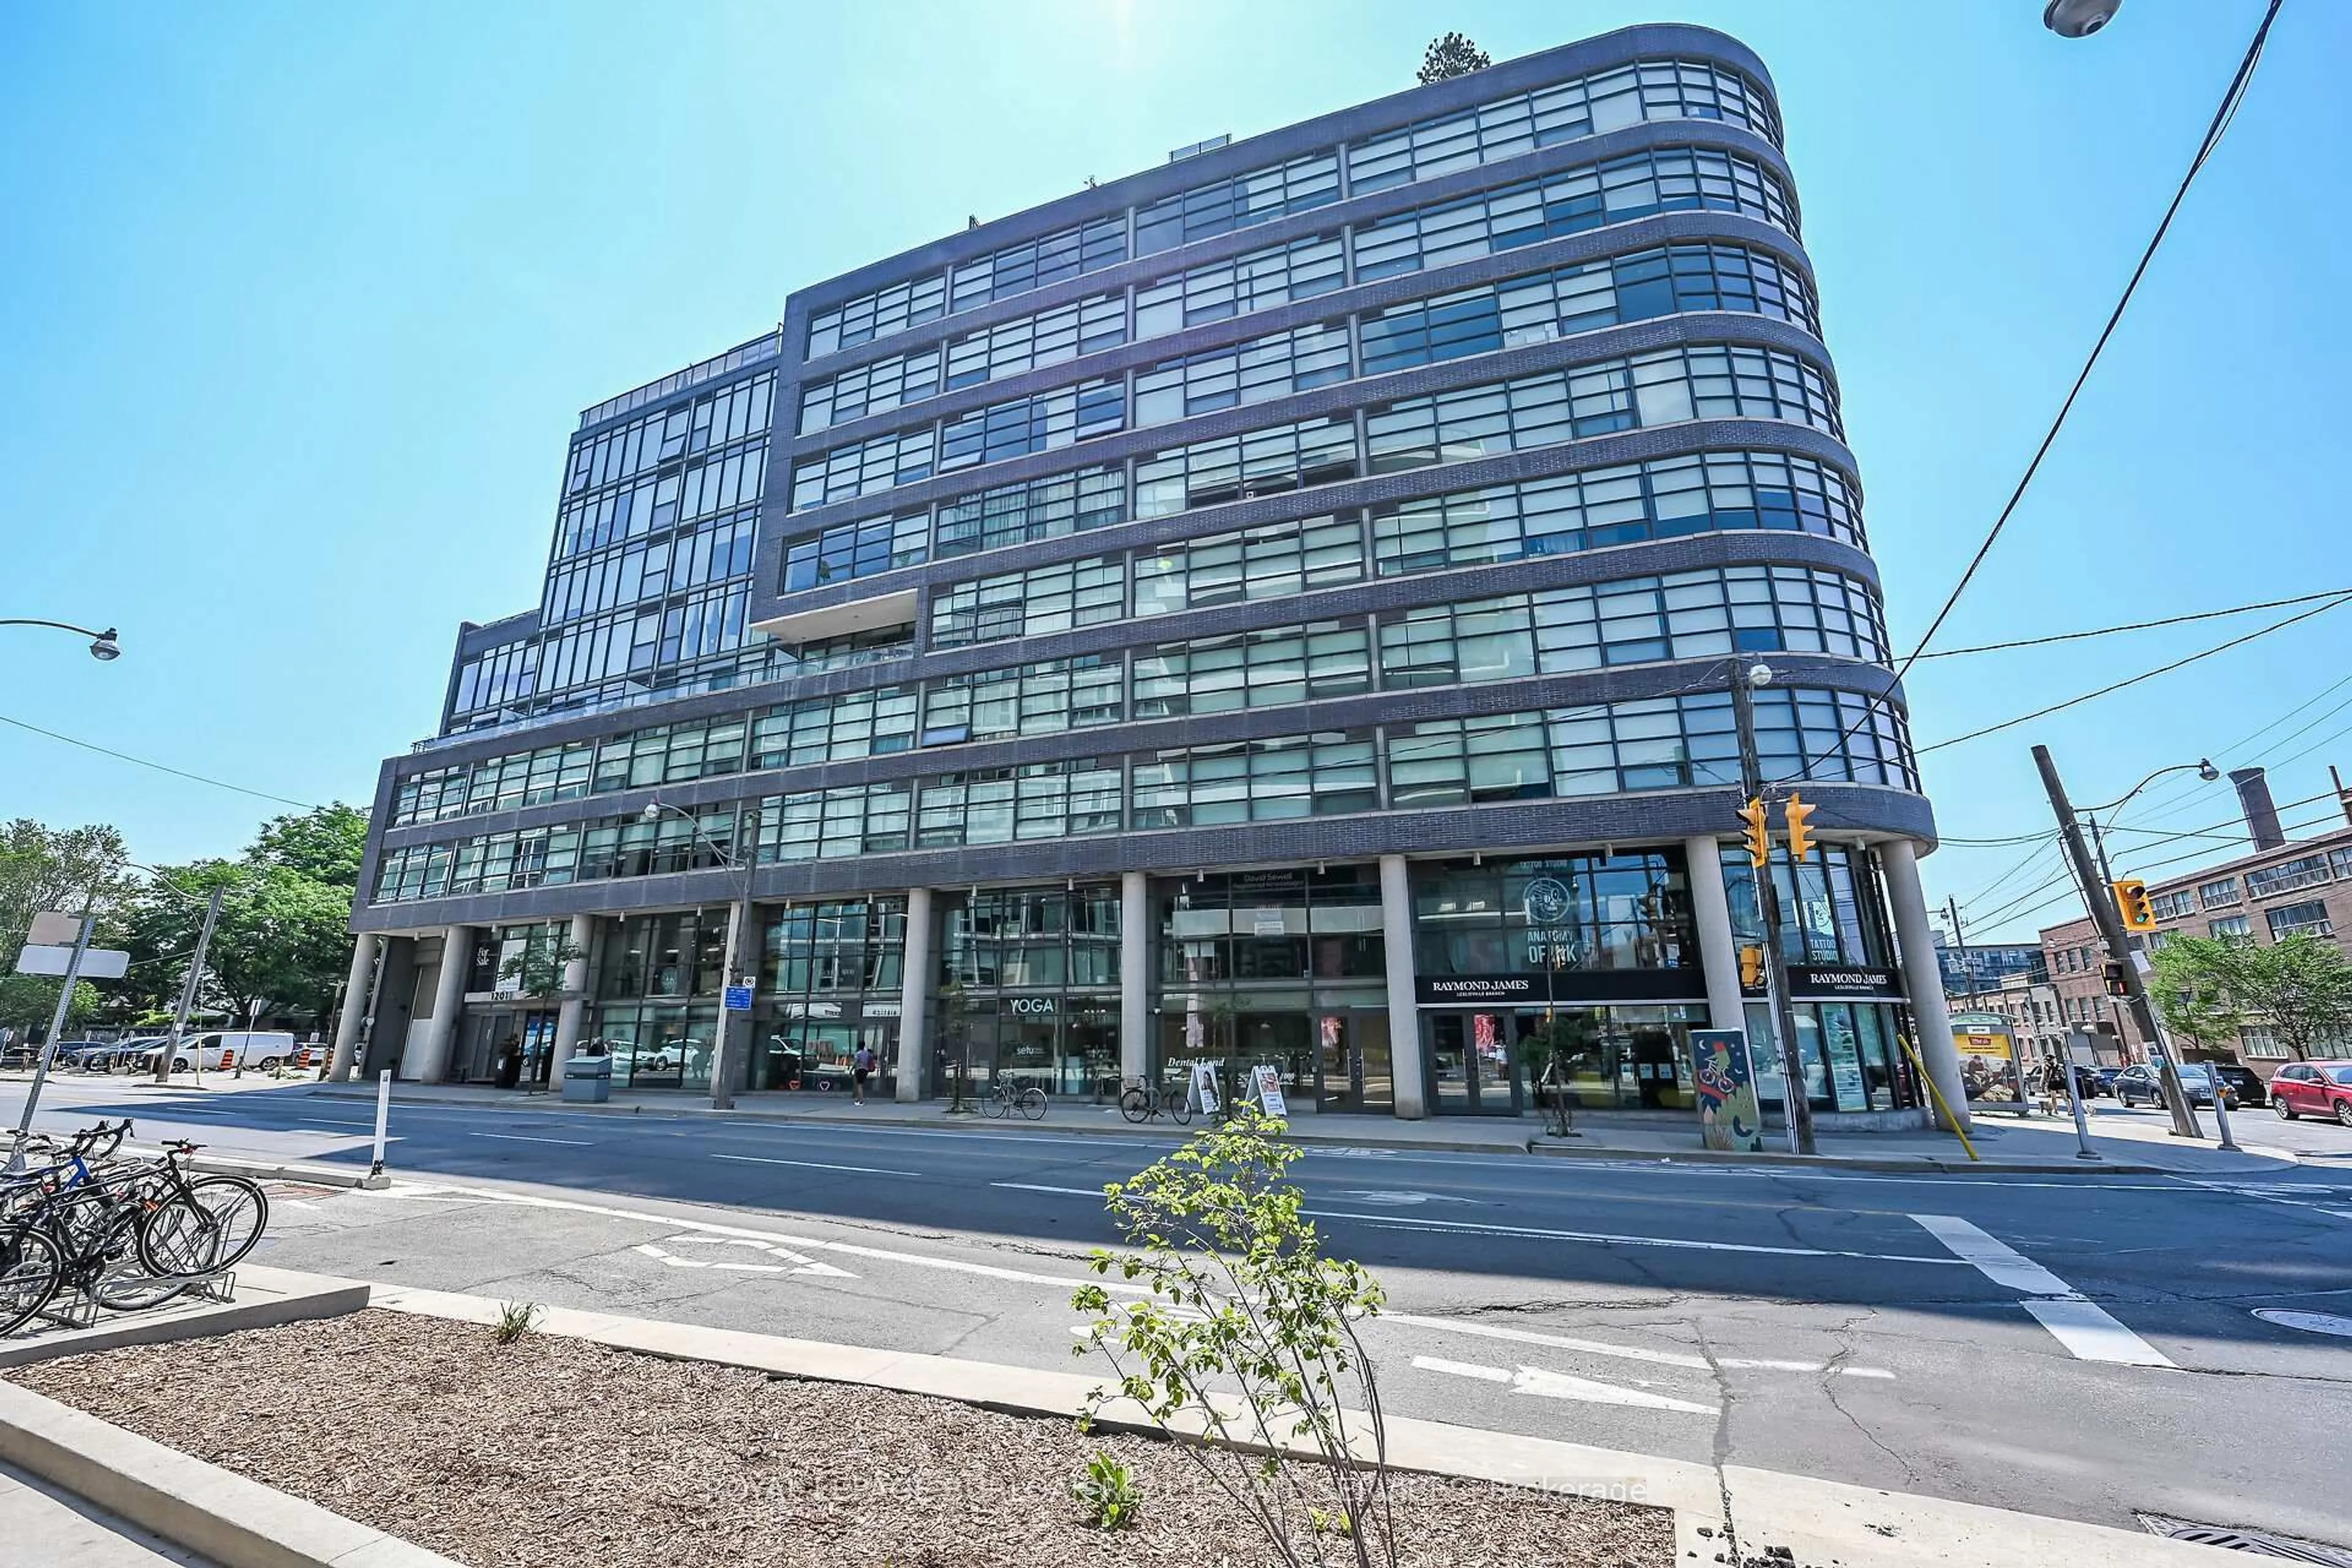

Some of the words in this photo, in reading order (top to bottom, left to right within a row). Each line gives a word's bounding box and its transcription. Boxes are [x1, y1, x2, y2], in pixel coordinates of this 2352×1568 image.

[1528, 930, 1574, 942] ANATOMY
[1810, 939, 1836, 949] TATTOO
[478, 947, 489, 957] For
[1529, 946, 1547, 963] OF
[1550, 944, 1577, 962] INK
[477, 957, 489, 967] Sale
[1810, 973, 1863, 984] RAYMOND
[1863, 974, 1888, 985] JAMES
[1433, 981, 1490, 991] RAYMOND
[1491, 979, 1529, 990] JAMES
[491, 992, 509, 1000] 1201
[1011, 998, 1055, 1013] YOGA
[1167, 1057, 1198, 1067] Dental
